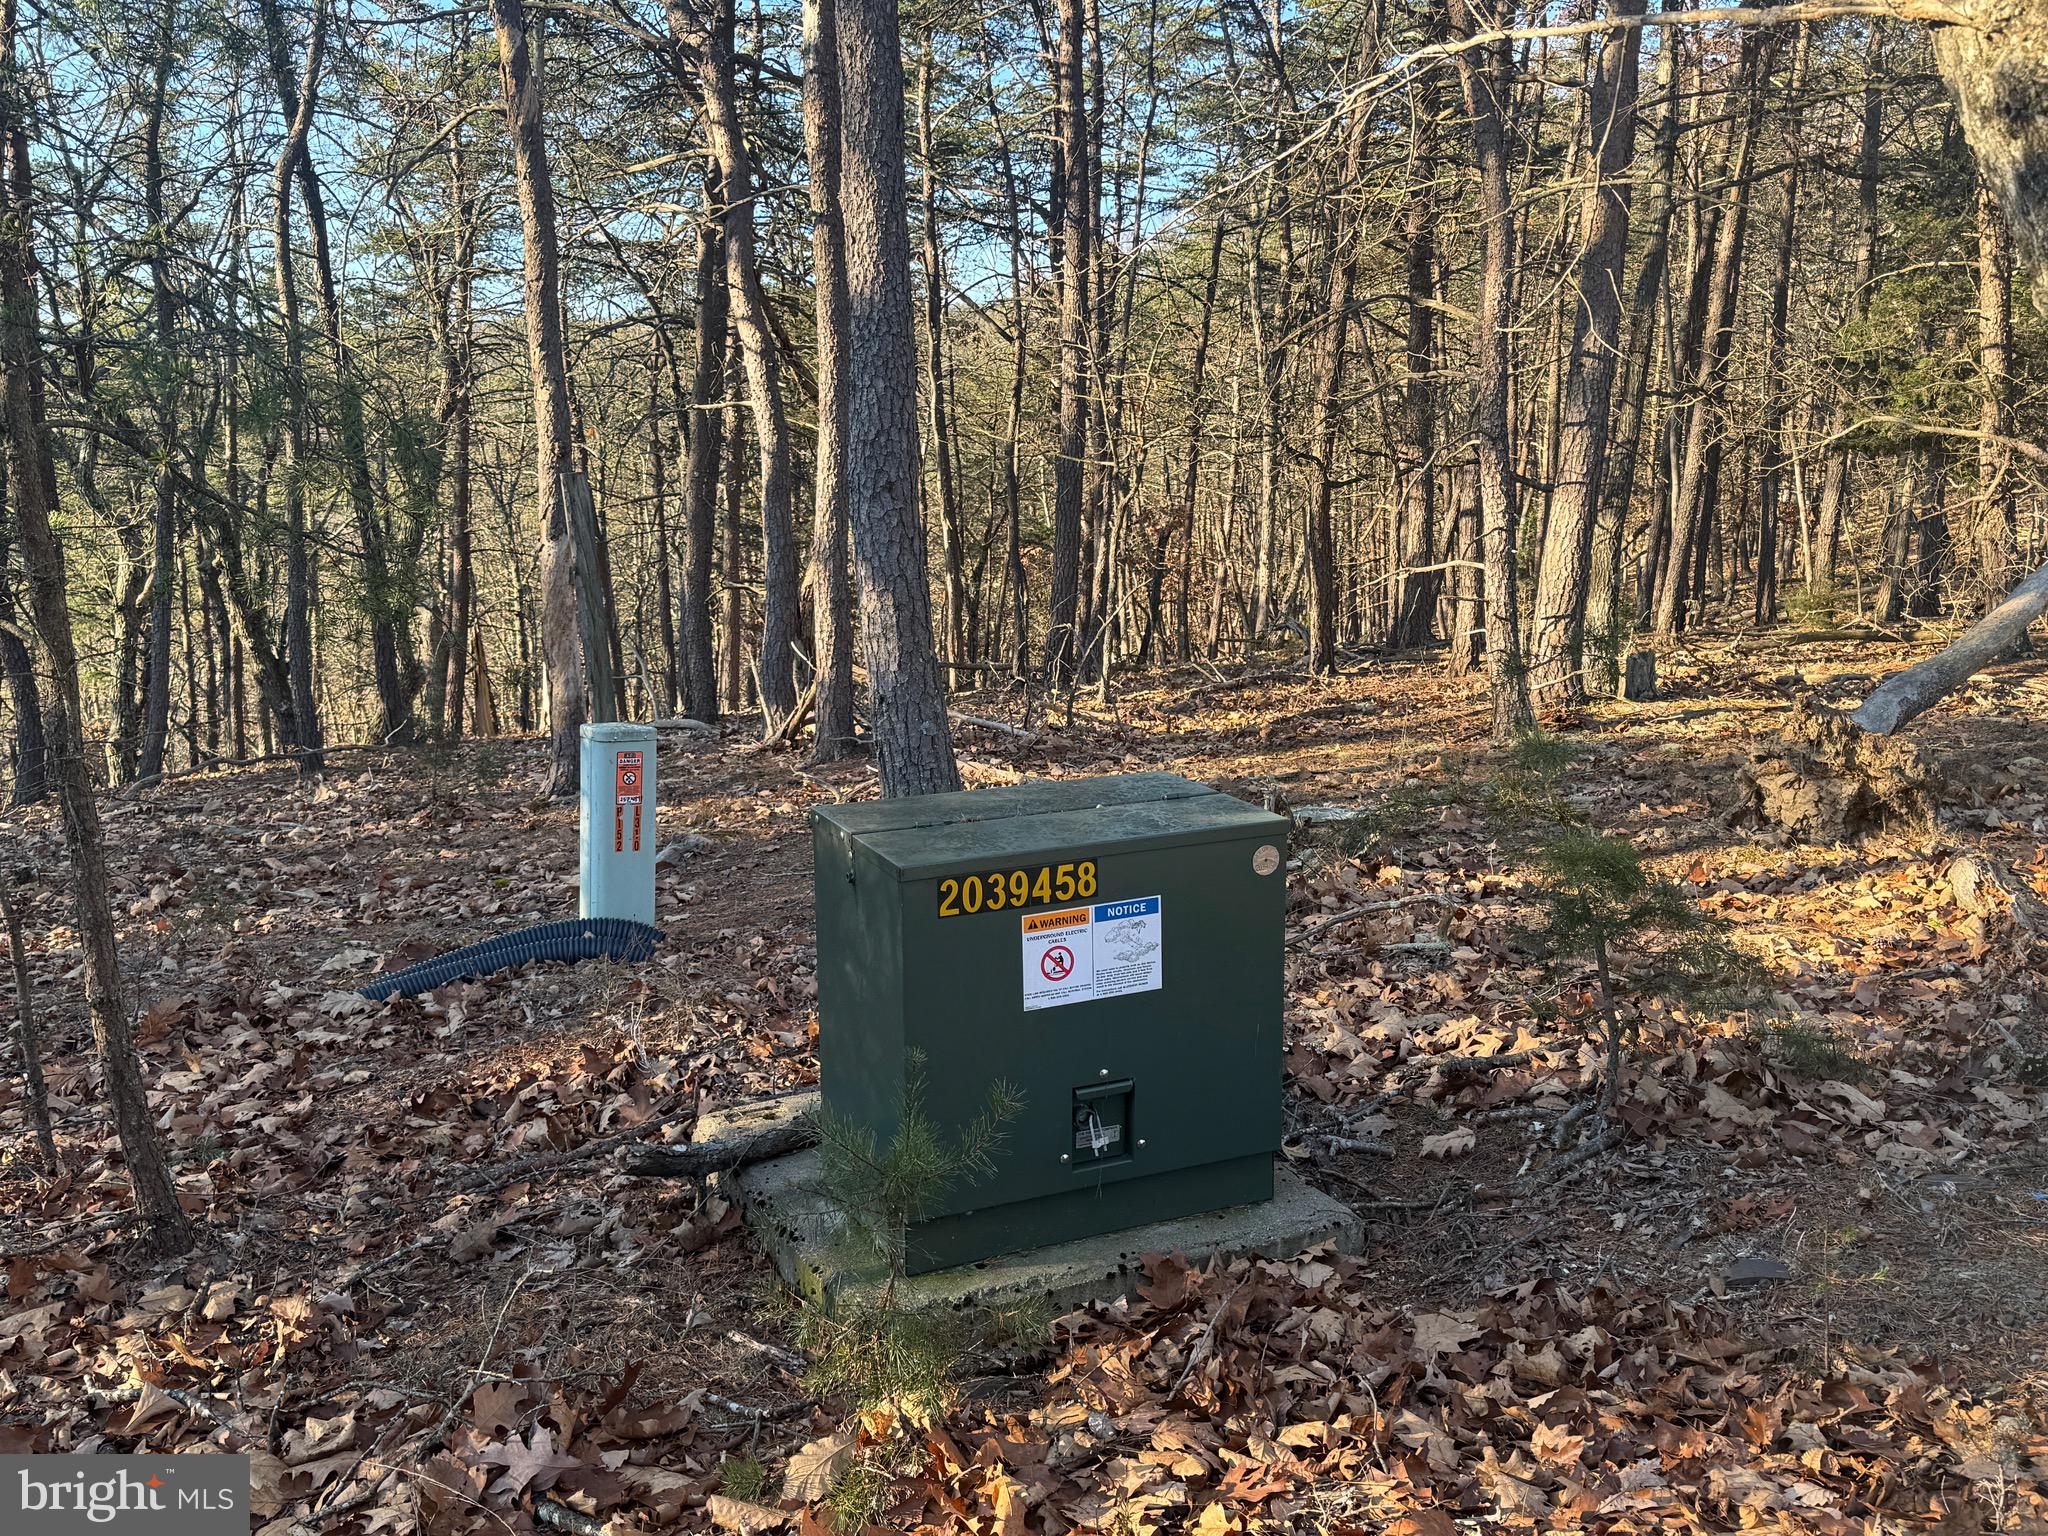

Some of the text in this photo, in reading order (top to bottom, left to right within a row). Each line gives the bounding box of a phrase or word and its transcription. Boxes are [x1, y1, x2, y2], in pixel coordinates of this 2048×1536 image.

[939, 862, 1097, 917] 2039458
[1107, 902, 1147, 917] NOTICE
[1040, 914, 1087, 928] WARNING
[1026, 928, 1088, 942] UNDERGROUND ELECTRIC
